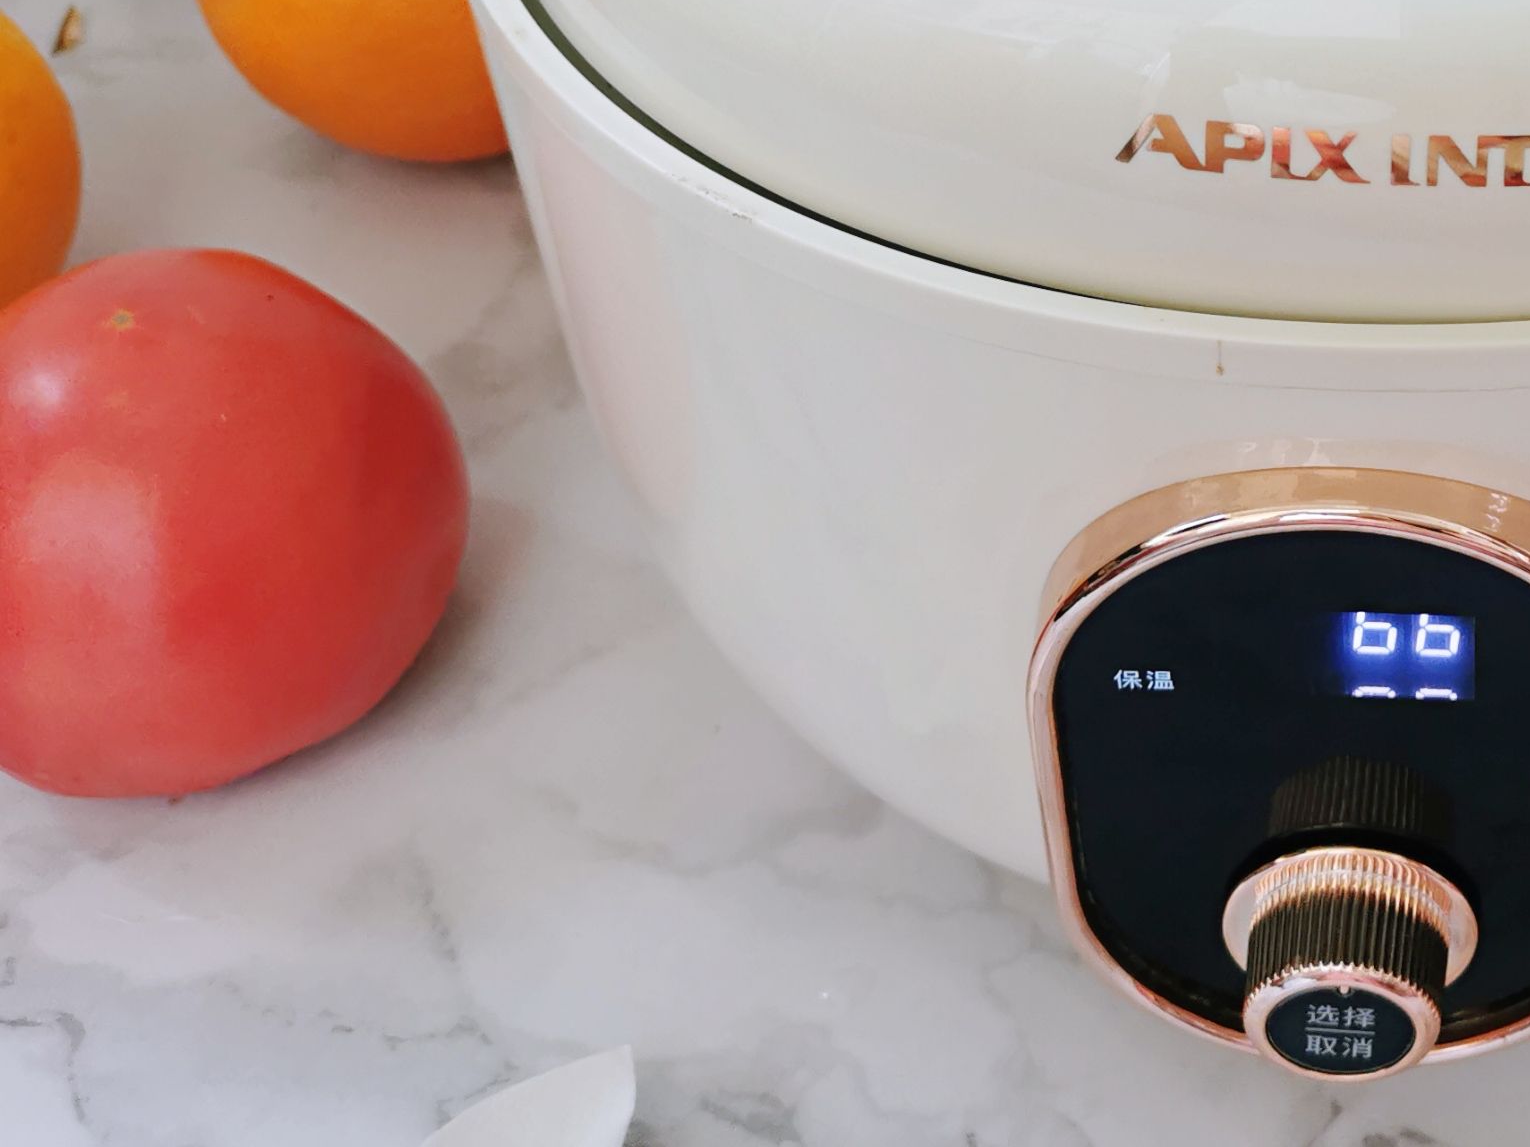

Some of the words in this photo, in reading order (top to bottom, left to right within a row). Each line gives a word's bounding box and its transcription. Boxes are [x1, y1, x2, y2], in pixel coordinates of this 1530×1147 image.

[1114, 113, 1371, 184] APIX
[1113, 669, 1175, 690] 保温
[1305, 1004, 1376, 1028] 选择
[1305, 1034, 1374, 1059] 取消
